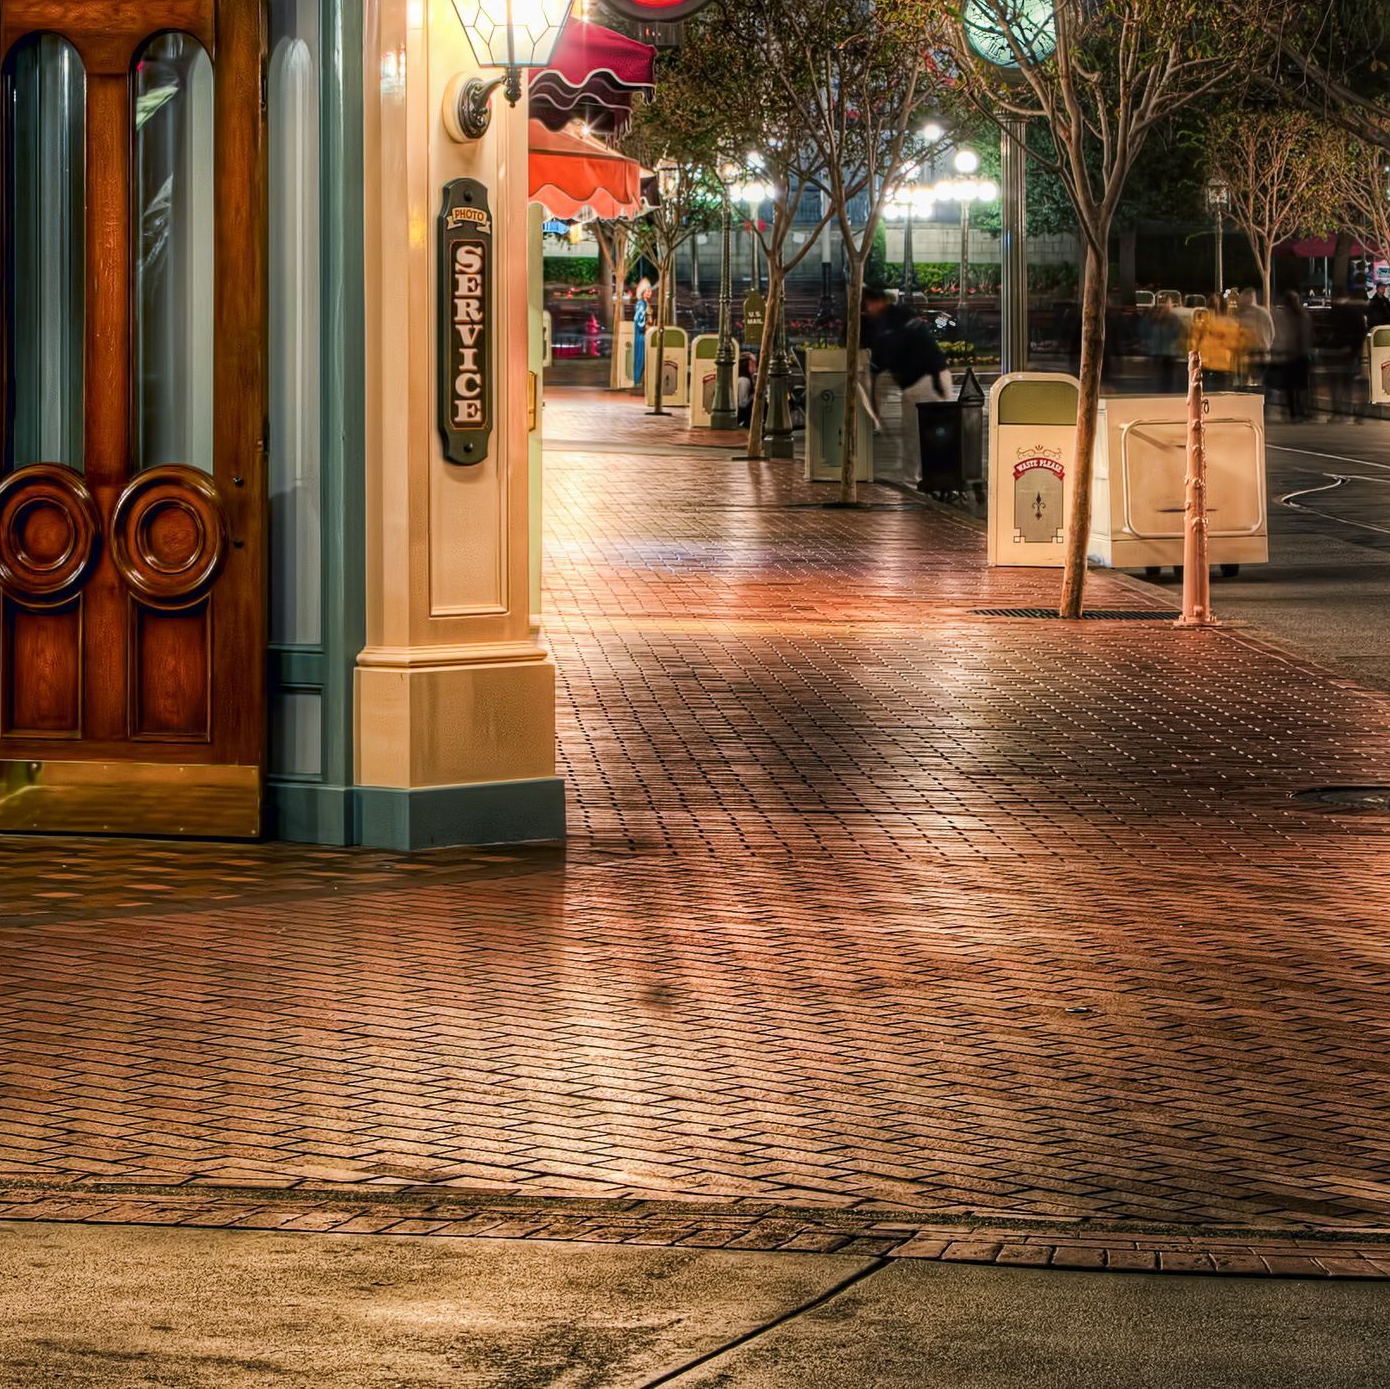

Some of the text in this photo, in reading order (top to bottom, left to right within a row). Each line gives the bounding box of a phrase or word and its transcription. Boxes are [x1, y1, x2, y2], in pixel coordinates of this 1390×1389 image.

[454, 209, 485, 223] PHOTO
[454, 245, 483, 424] SERVICE
[1016, 459, 1038, 472] WASTE
